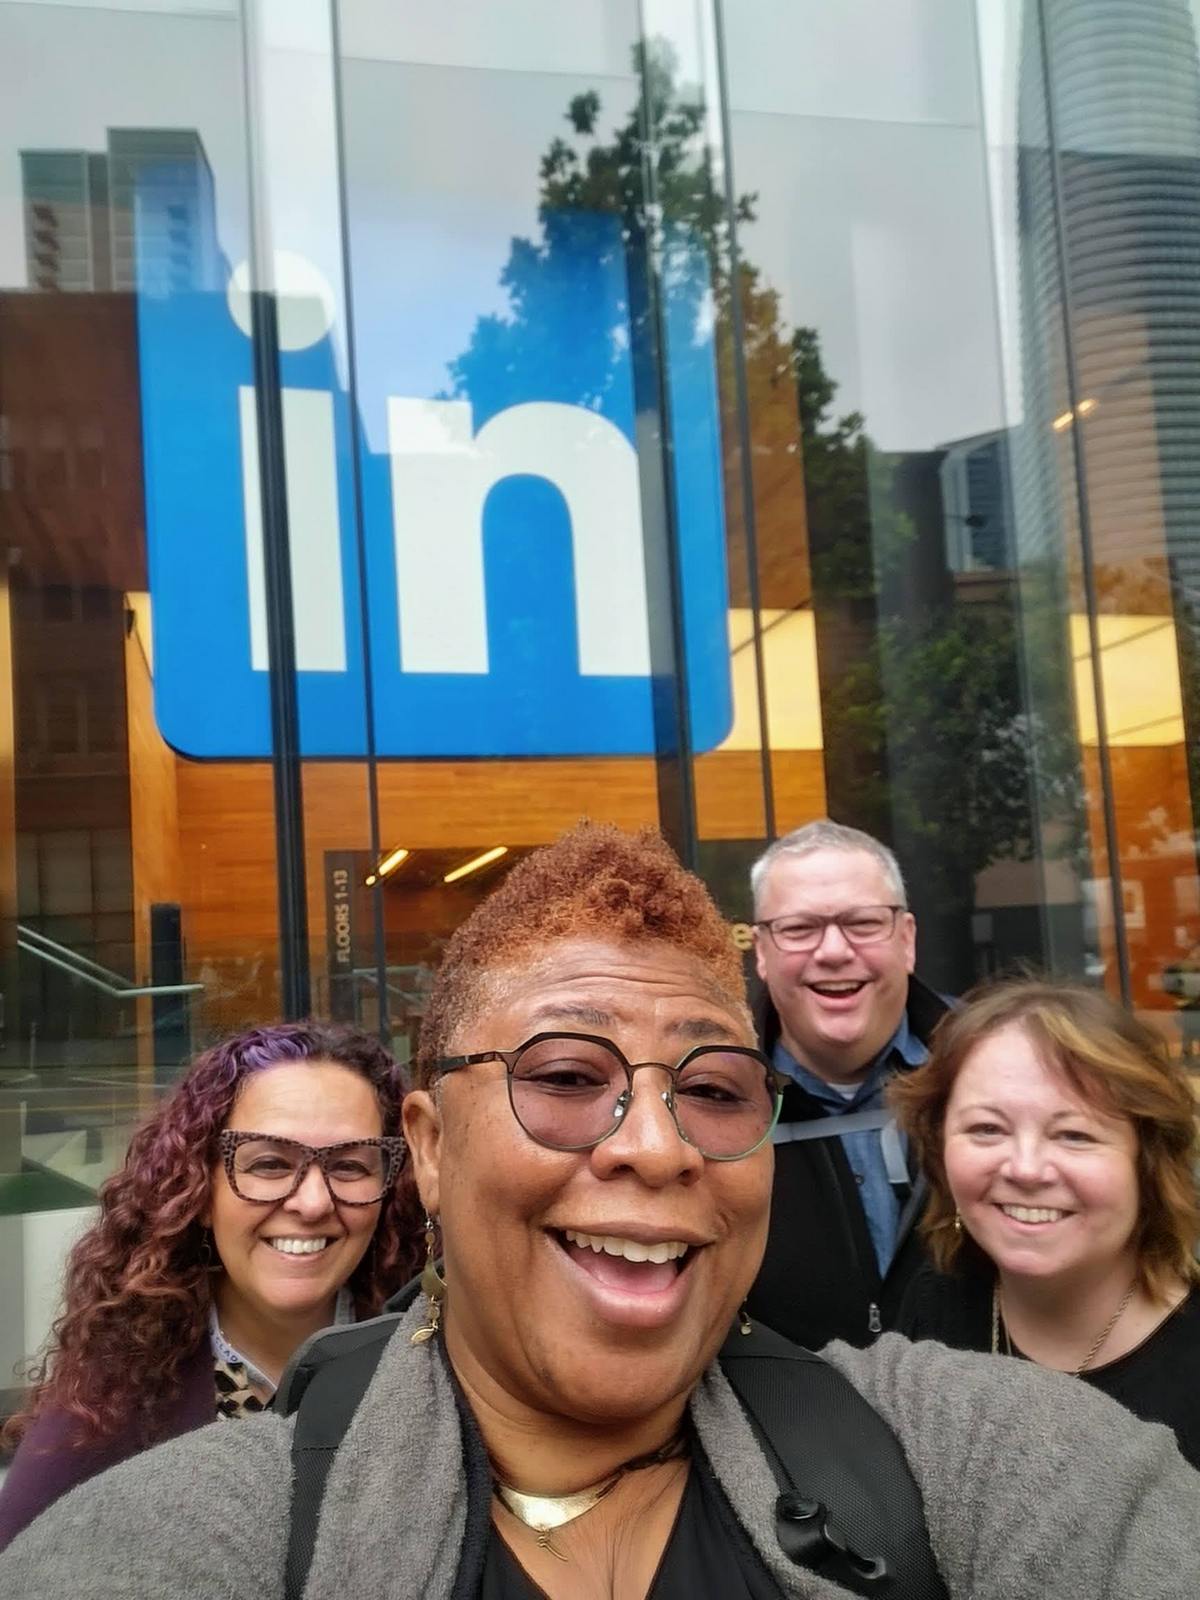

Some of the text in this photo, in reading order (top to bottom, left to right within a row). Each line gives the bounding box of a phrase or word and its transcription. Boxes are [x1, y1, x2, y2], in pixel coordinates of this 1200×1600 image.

[227, 249, 662, 677] in
[333, 870, 350, 962] FLOORS 1-13
